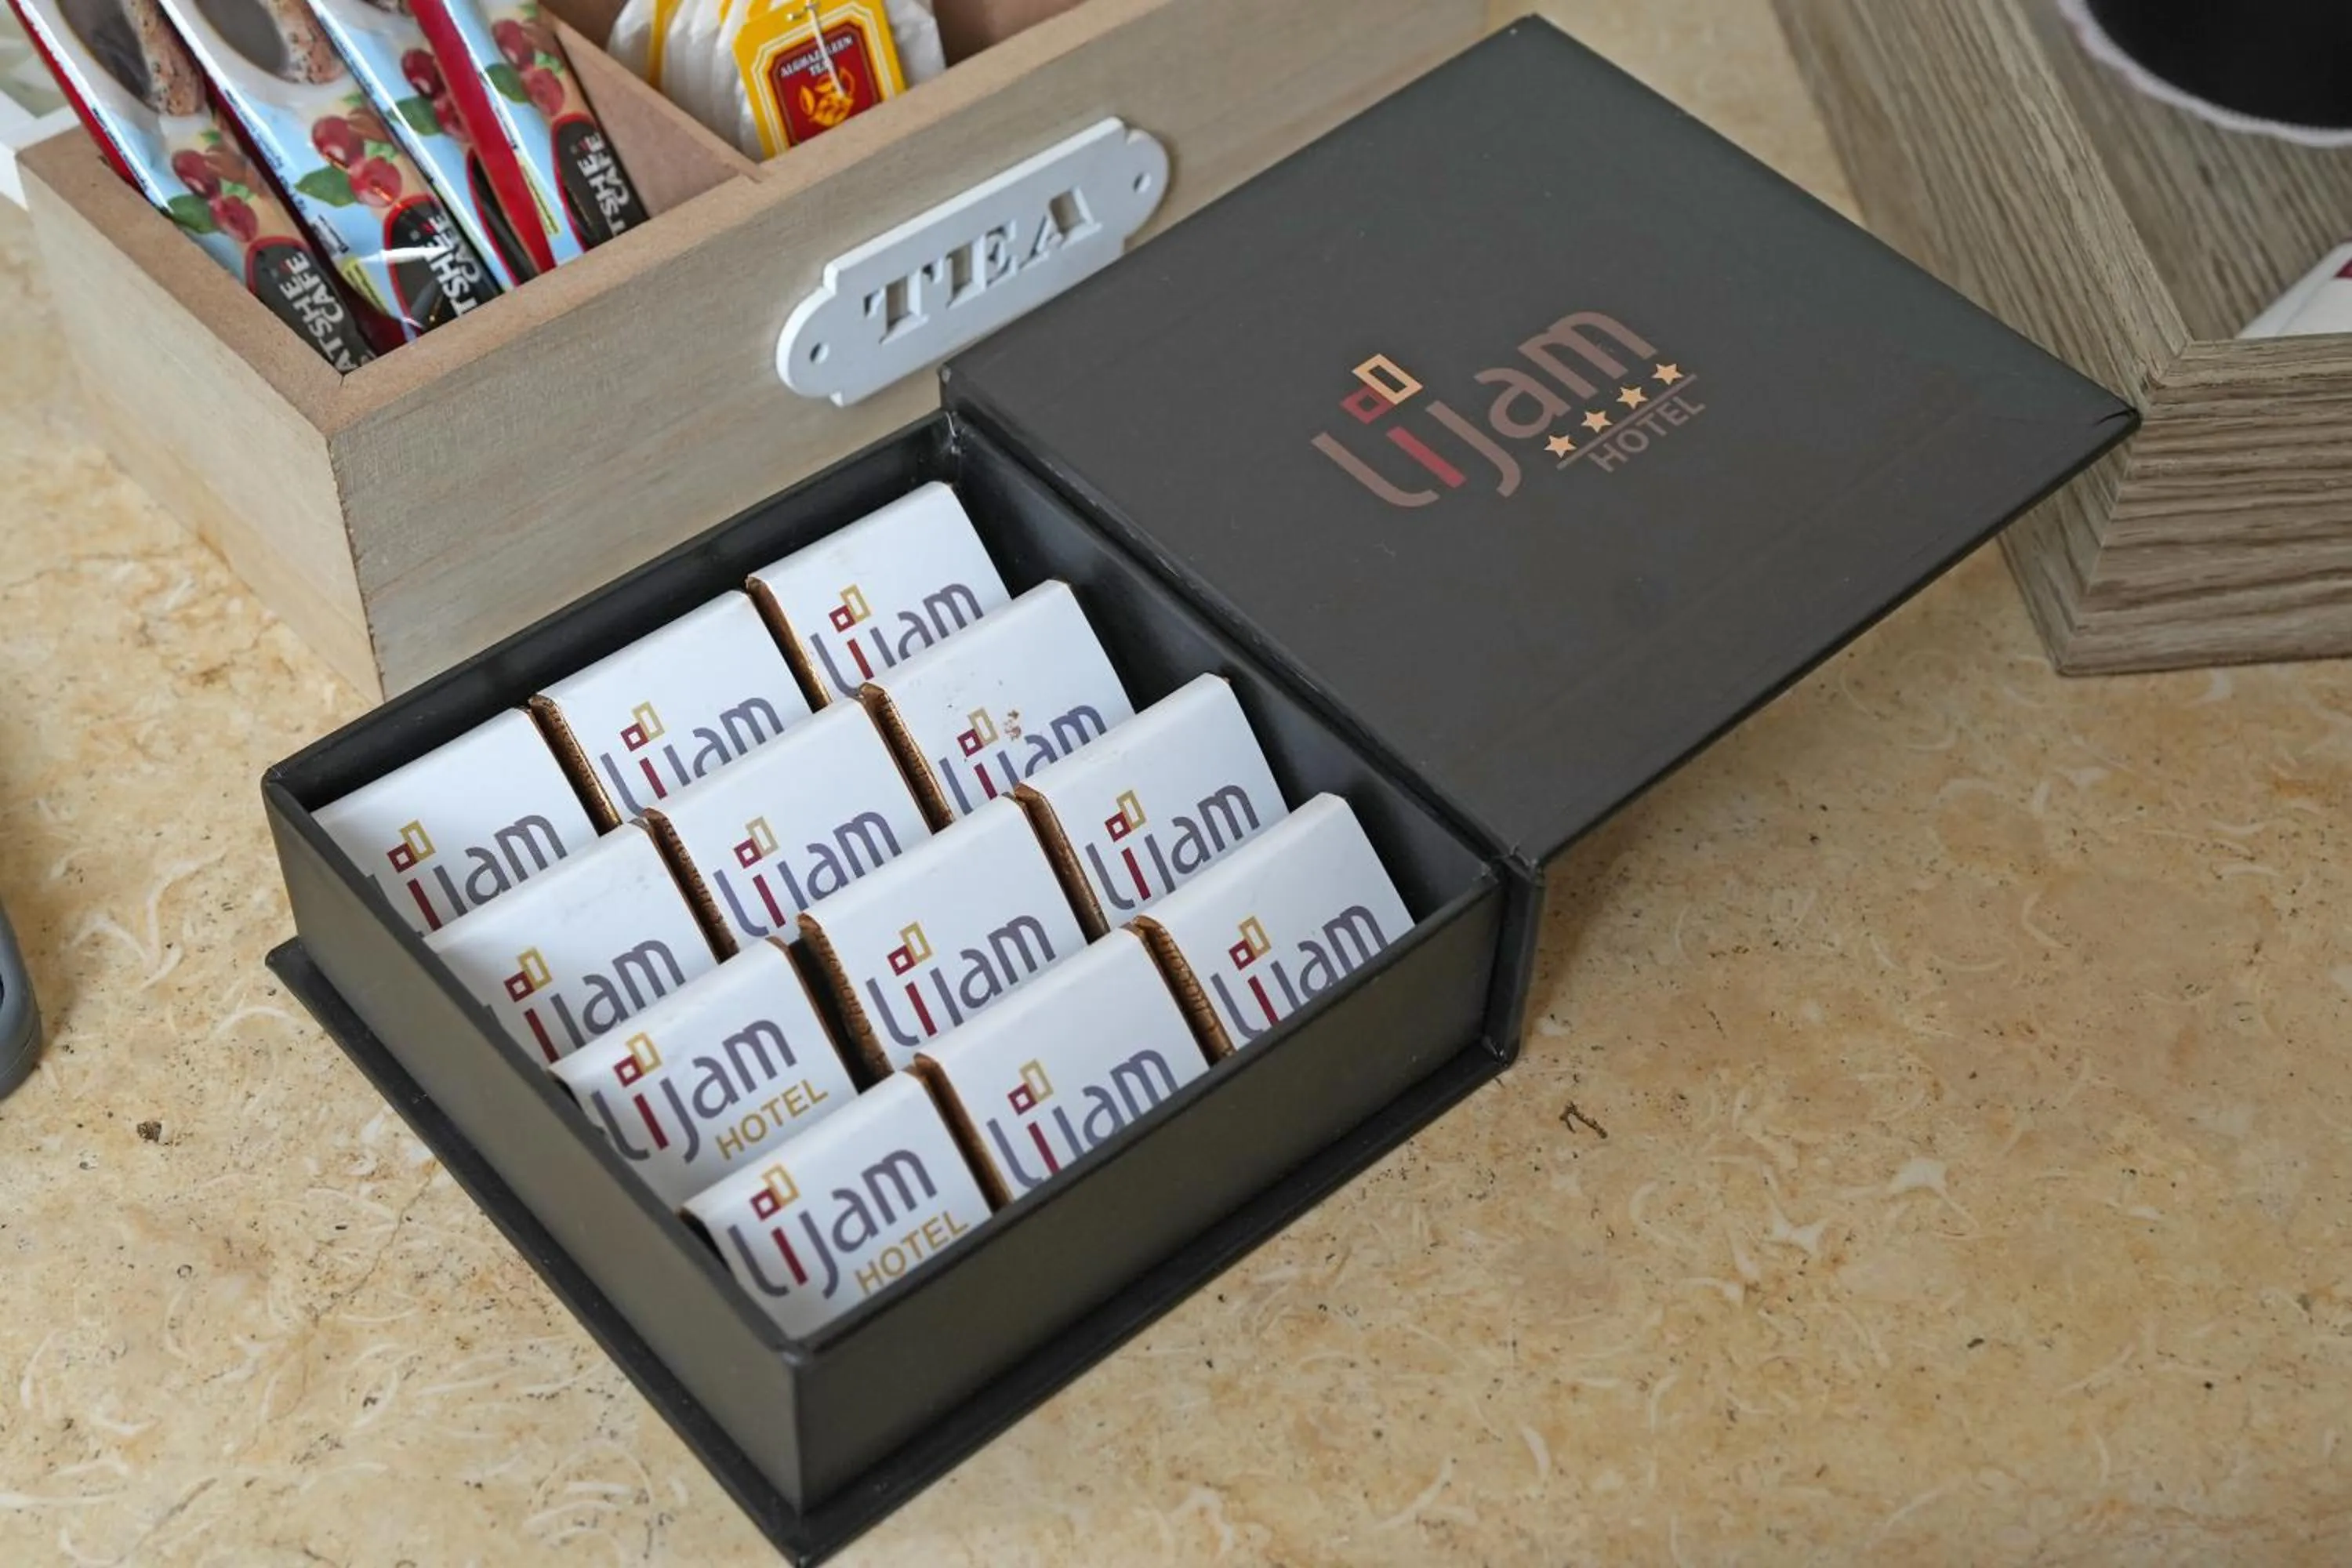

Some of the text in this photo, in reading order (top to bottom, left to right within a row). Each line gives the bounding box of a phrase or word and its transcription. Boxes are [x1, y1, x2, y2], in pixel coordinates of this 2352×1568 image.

[577, 156, 626, 236] TSHE
[863, 185, 1103, 345] TEA
[279, 275, 362, 372] ATSHE
[1588, 395, 1706, 473] HOTEL
[715, 1079, 829, 1161] HOTEL
[855, 1210, 970, 1294] HOTEL
